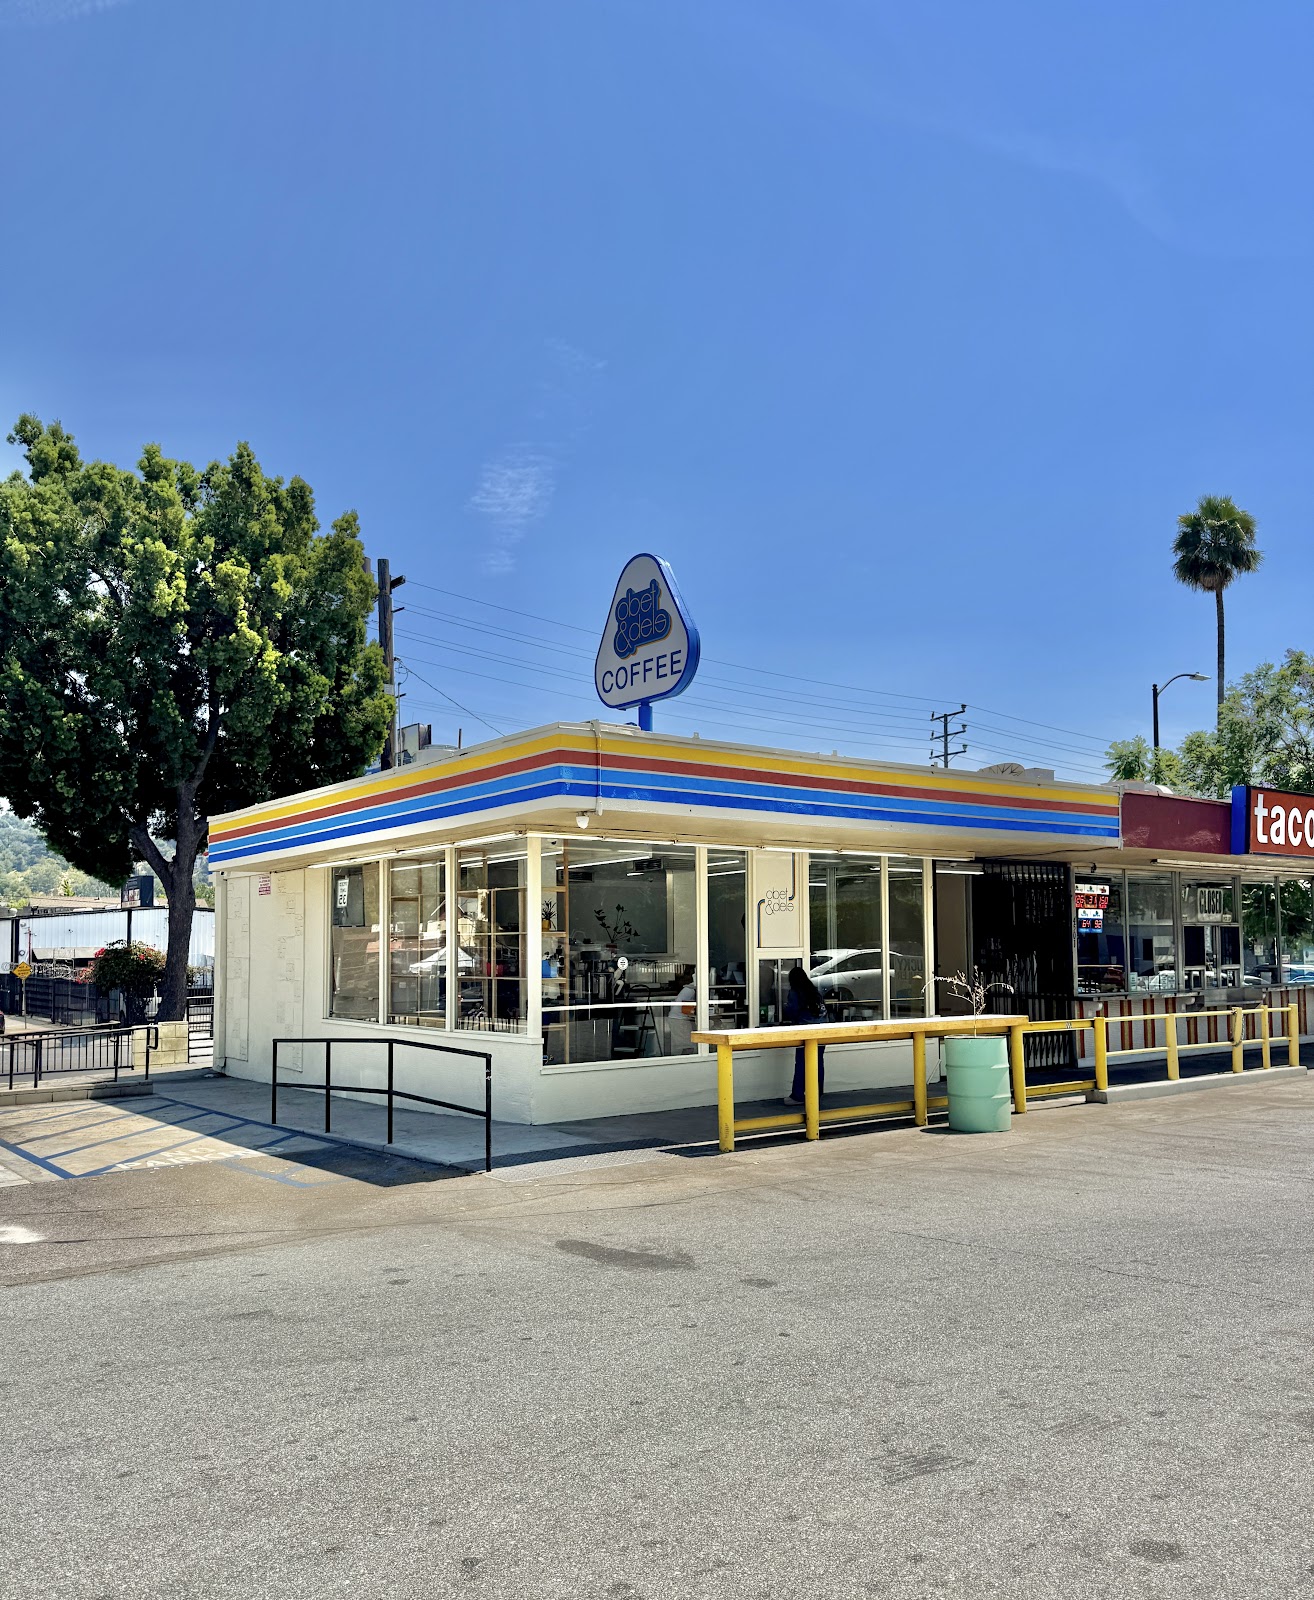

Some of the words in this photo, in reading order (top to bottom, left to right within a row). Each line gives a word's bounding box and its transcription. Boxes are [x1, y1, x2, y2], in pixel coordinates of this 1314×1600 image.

[602, 649, 682, 693] COFFEE
[1254, 793, 1314, 848] taco
[1200, 890, 1222, 914] CLOSED
